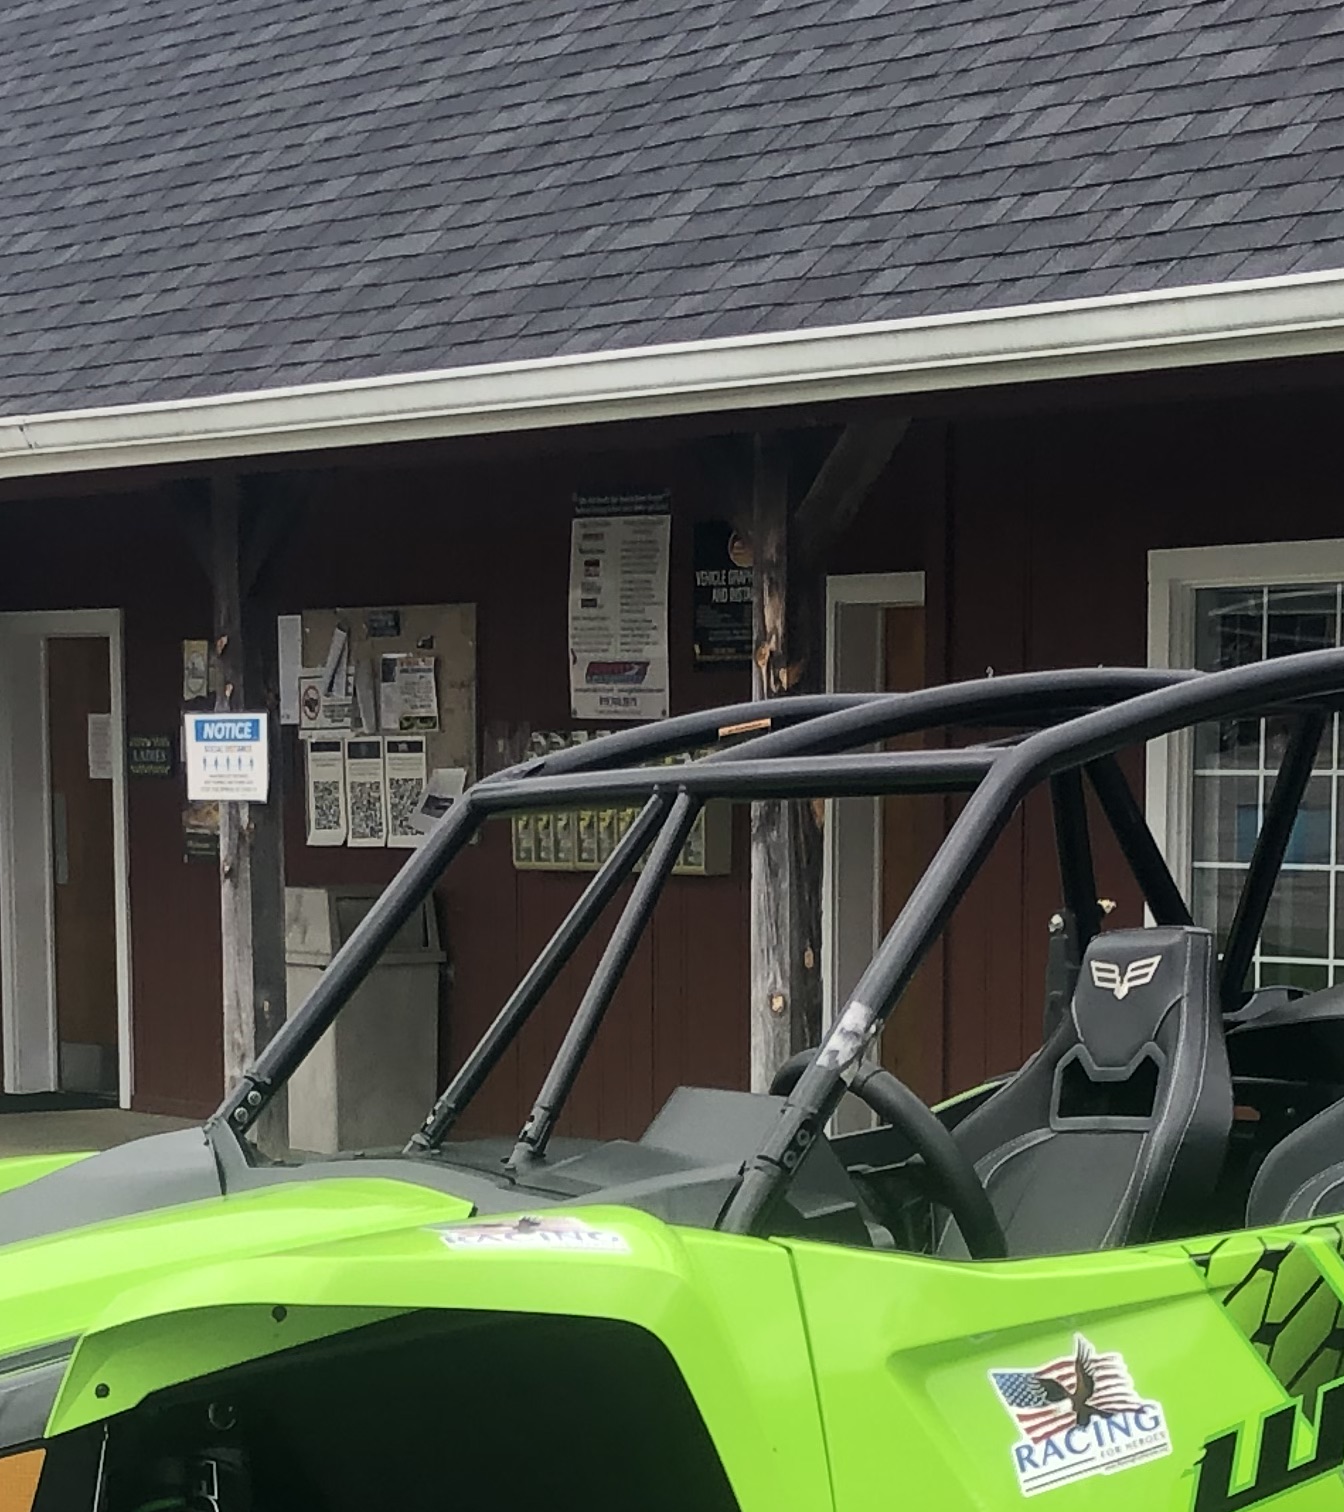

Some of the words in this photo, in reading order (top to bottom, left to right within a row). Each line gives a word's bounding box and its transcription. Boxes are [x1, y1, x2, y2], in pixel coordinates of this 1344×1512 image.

[203, 721, 253, 740] NOTICE
[1015, 1403, 1161, 1474] RACING
[1100, 1445, 1123, 1458] FOR
[1125, 1432, 1167, 1452] HEROES
